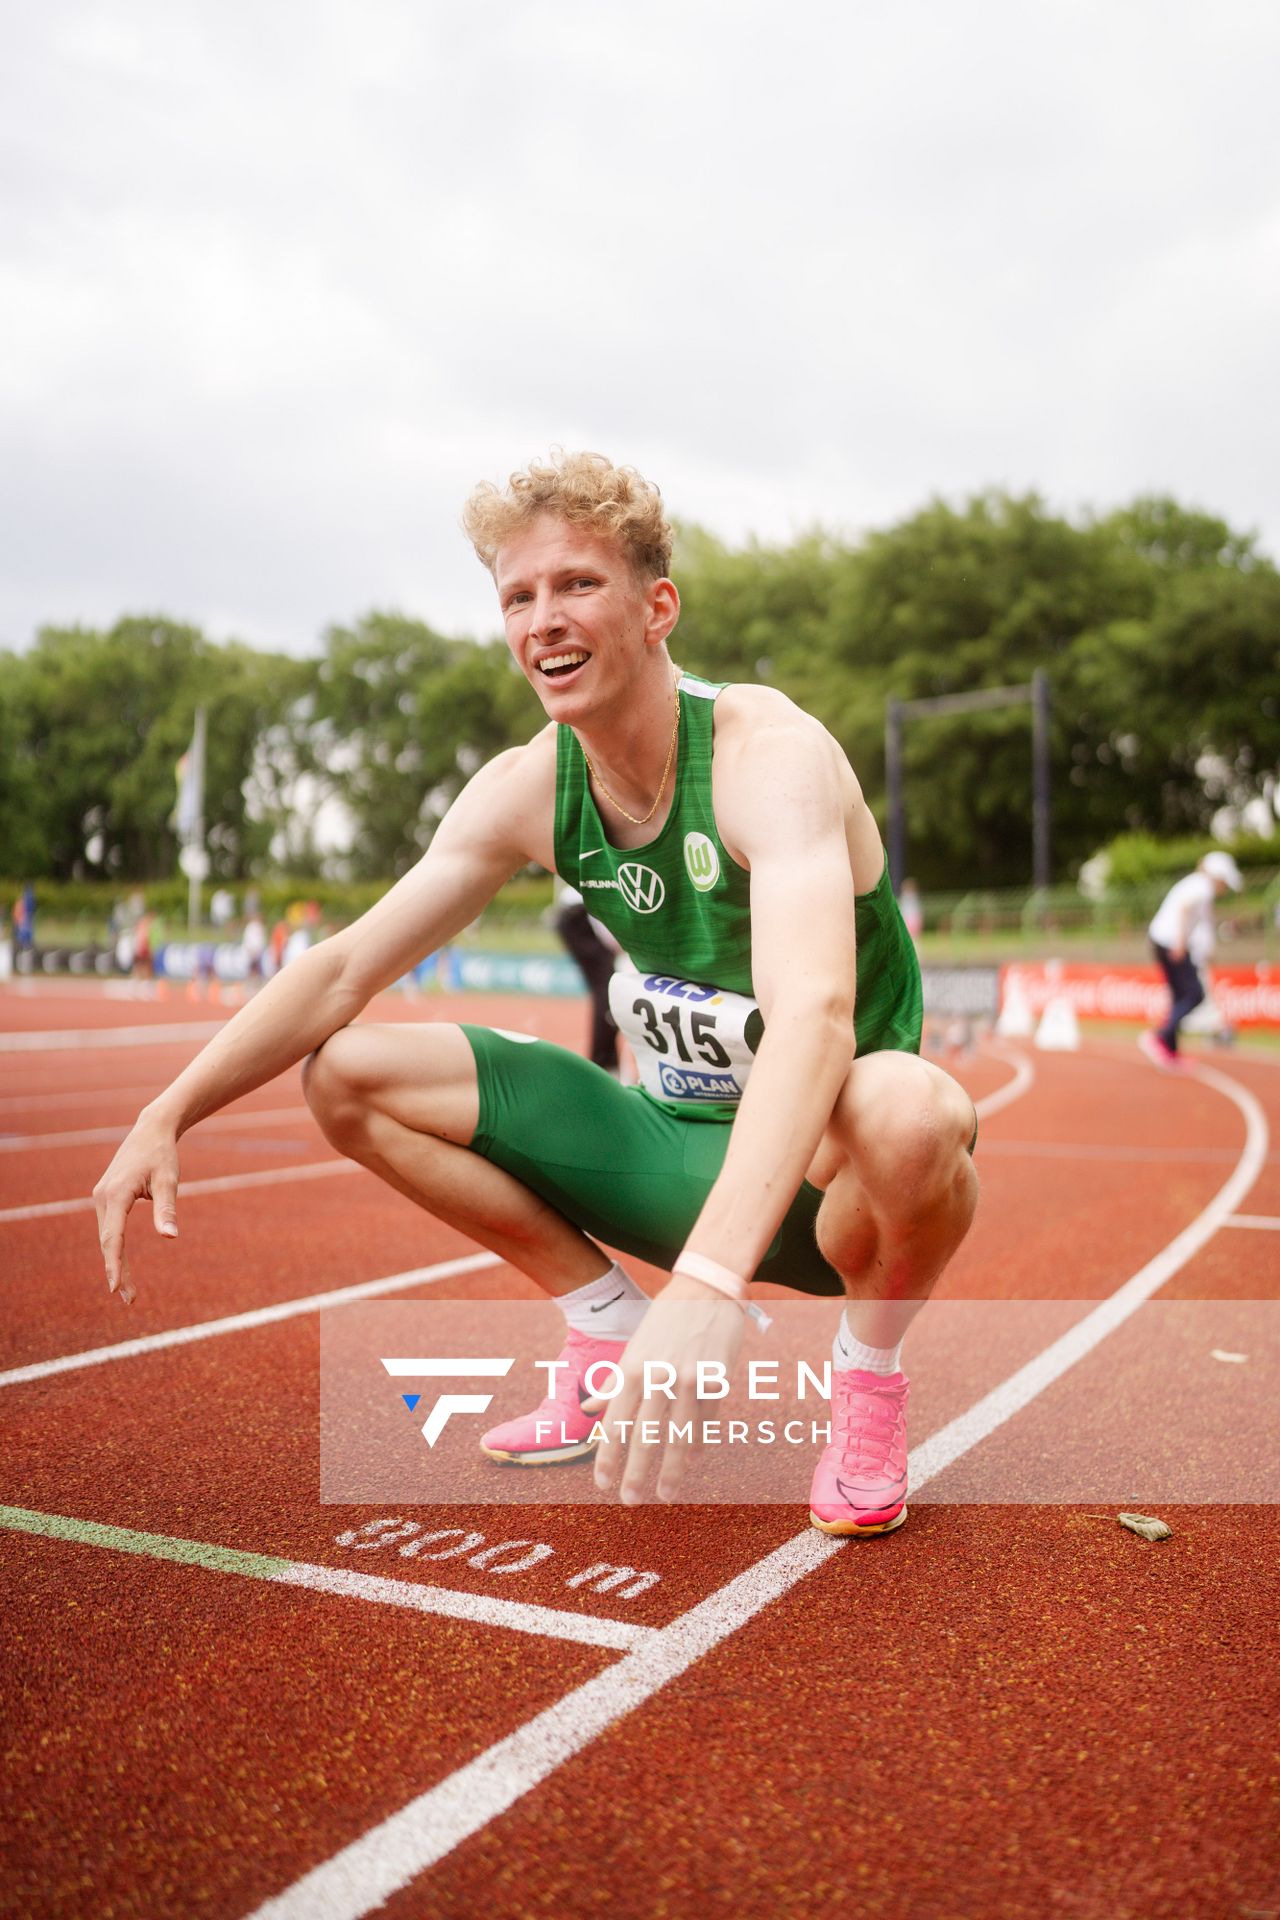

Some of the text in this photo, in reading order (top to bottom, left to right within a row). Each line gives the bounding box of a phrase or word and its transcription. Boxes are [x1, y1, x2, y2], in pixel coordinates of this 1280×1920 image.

[632, 998, 732, 1068] 315
[686, 1075, 738, 1094] PLAN
[566, 1562, 661, 1600] m
